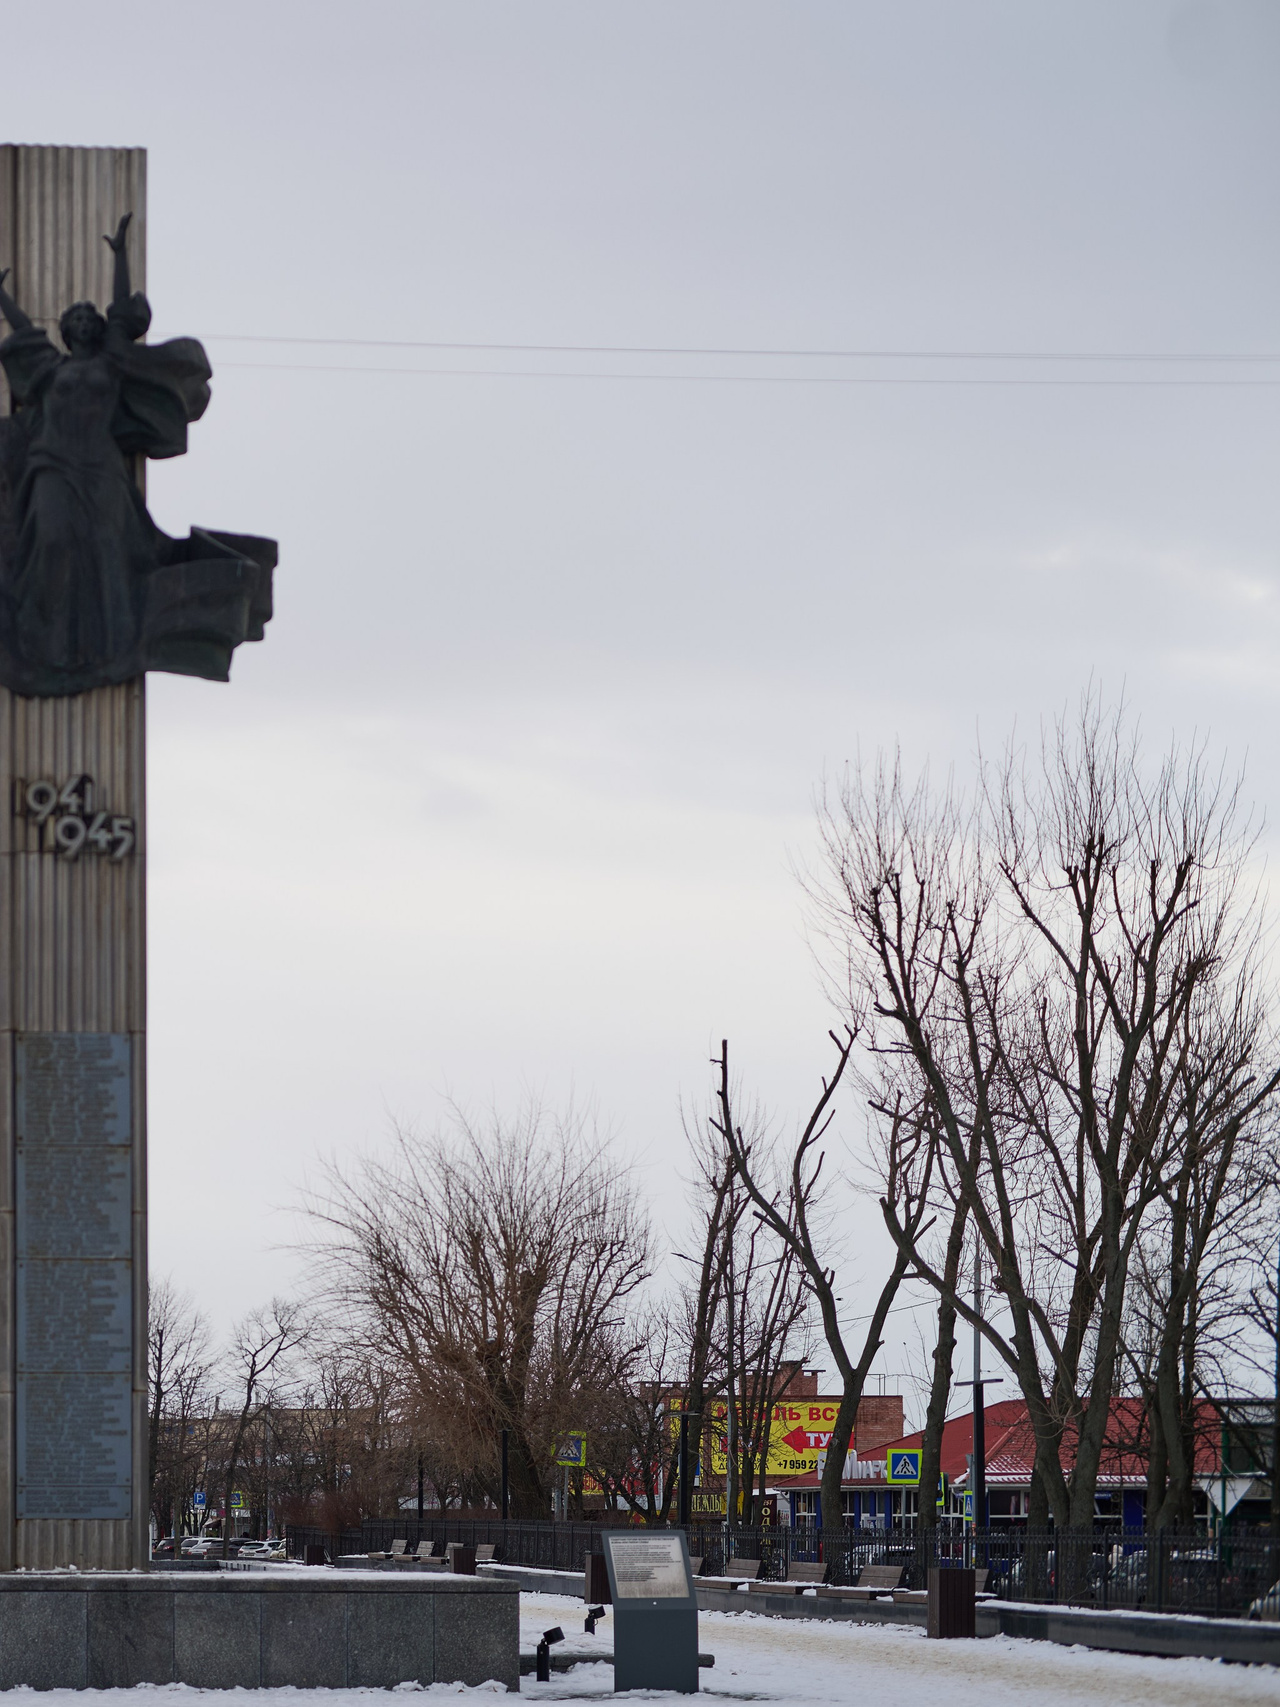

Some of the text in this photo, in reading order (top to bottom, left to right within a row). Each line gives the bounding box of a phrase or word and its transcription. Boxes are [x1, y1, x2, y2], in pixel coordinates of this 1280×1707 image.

[14, 774, 93, 823] 1941
[45, 811, 135, 860] 1945
[808, 1406, 840, 1421] ВС
[806, 1432, 834, 1447] ТУ
[789, 1459, 807, 1470] 959
